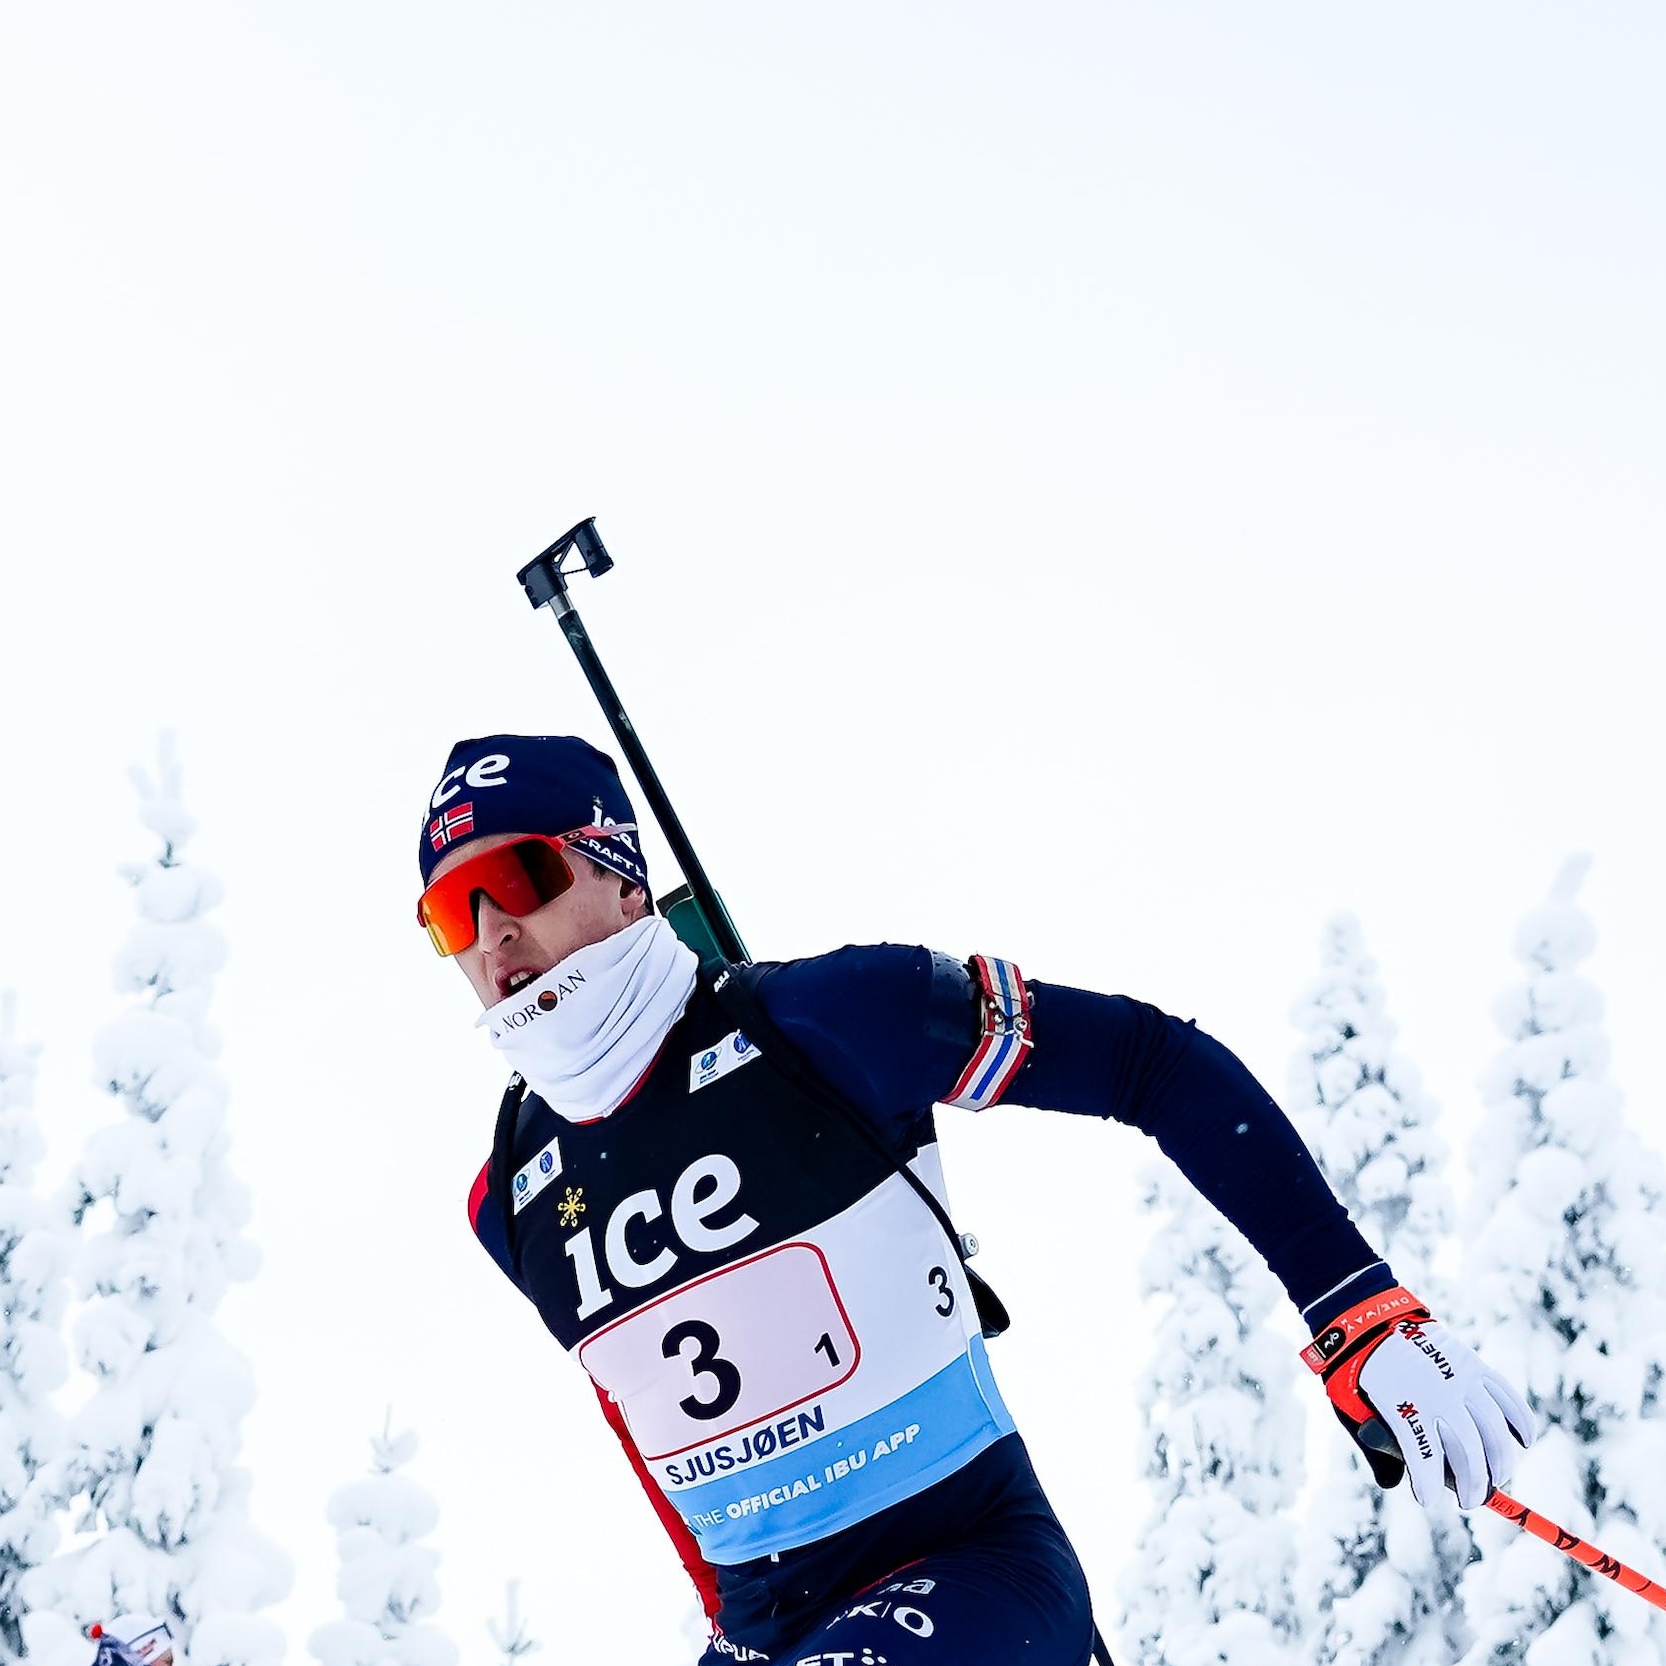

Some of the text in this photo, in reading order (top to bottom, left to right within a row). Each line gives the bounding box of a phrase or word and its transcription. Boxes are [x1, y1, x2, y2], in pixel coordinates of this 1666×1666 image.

[564, 1153, 760, 1321] ice
[928, 1265, 955, 1317] 3
[661, 1319, 841, 1420] 3 1
[665, 1405, 825, 1485] SJUSJØEN
[694, 1423, 922, 1528] THE OFFICIAL IBU APP
